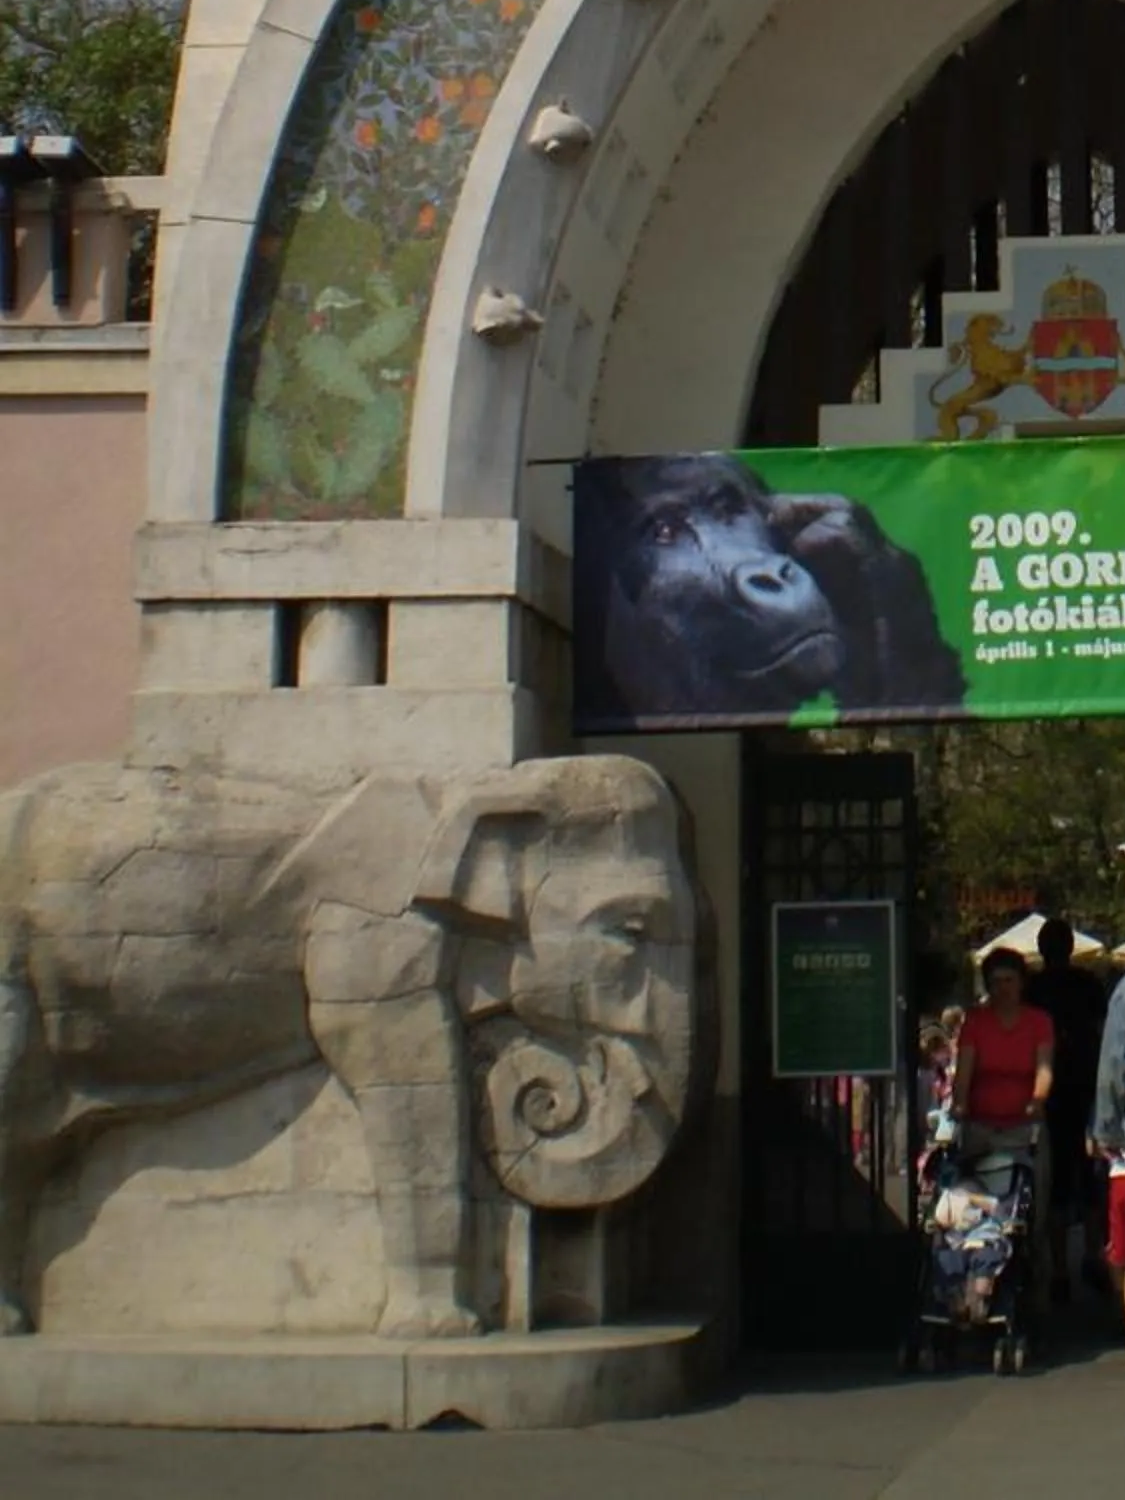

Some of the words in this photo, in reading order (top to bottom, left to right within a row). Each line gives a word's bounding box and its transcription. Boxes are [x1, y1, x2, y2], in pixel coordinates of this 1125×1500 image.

[969, 510, 1092, 550] 2009.
[970, 556, 1004, 592] A
[975, 639, 1038, 664] április
[1045, 639, 1055, 658] 1
